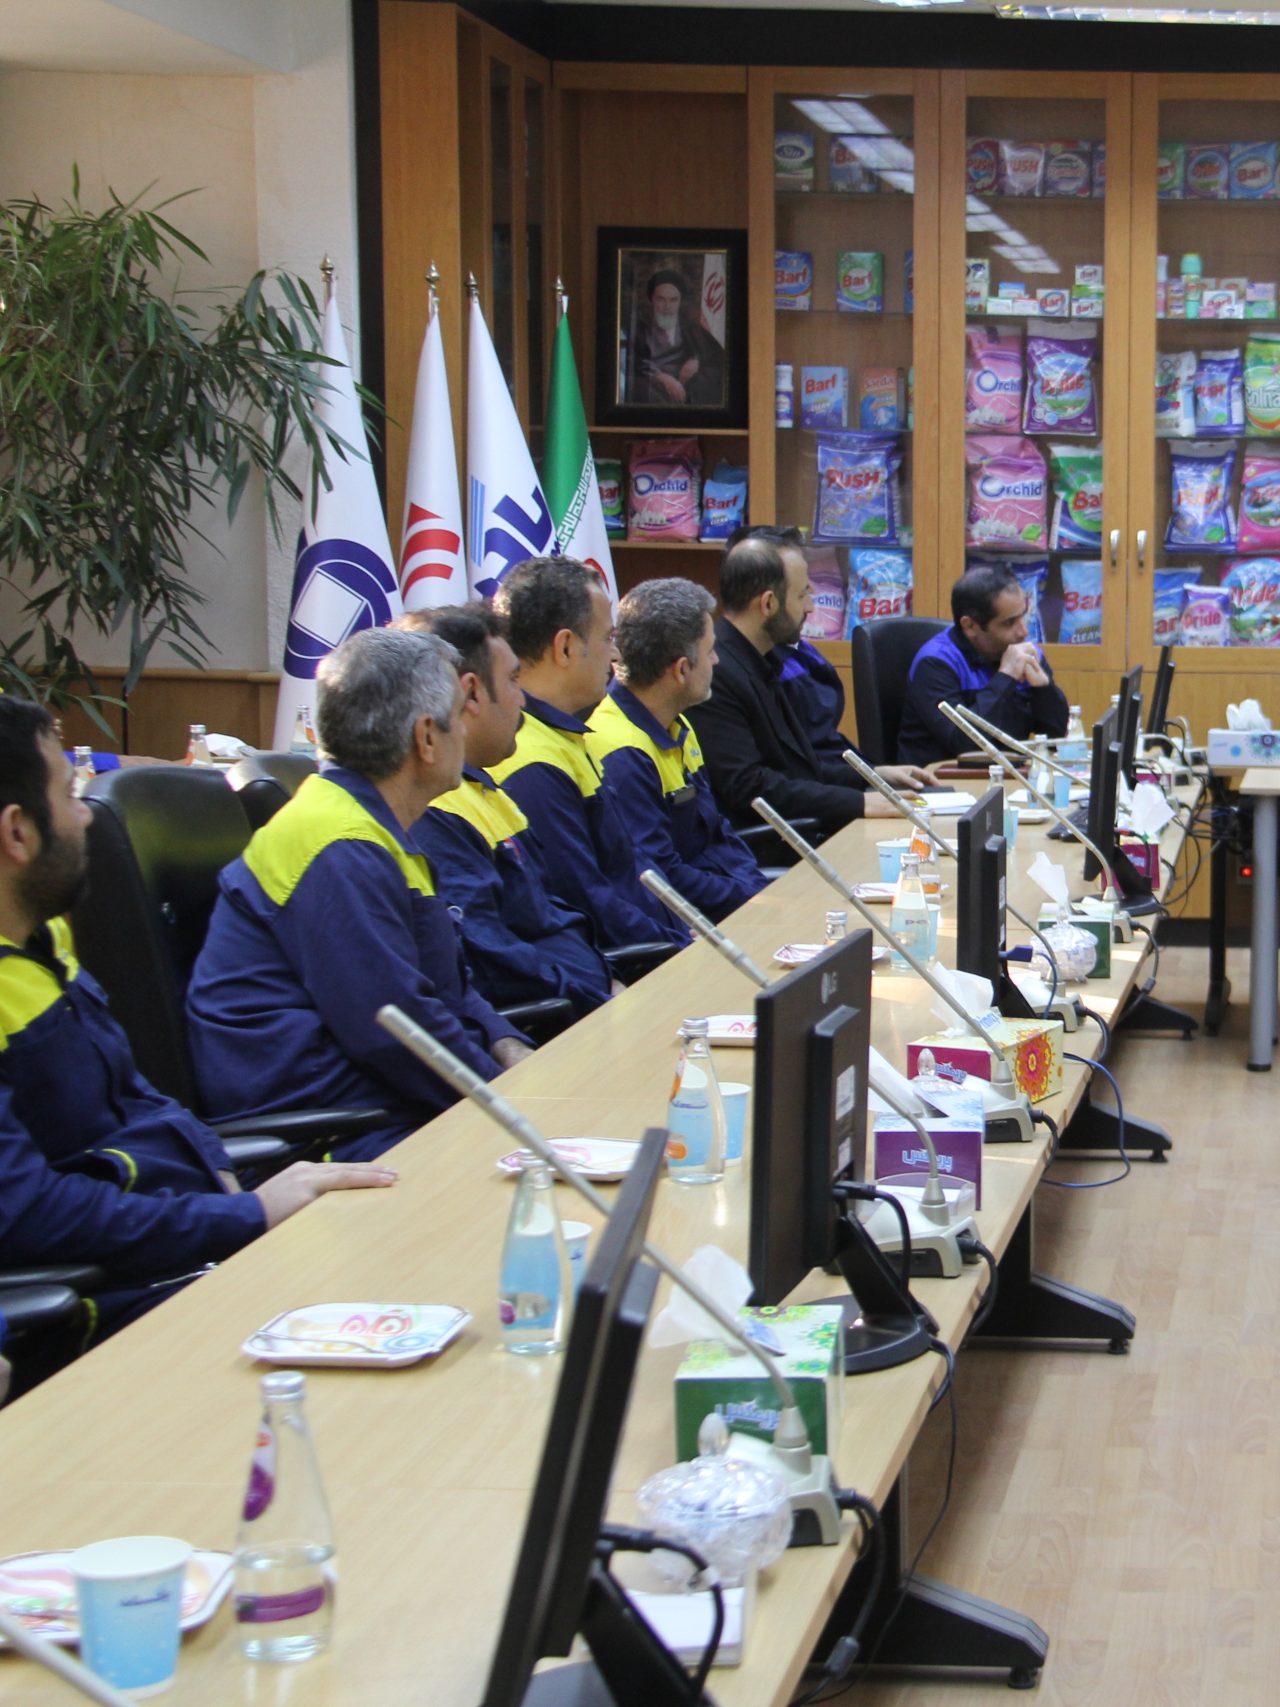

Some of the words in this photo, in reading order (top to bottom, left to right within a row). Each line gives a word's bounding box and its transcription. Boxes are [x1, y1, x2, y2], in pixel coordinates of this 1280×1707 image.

[805, 373, 836, 395] Barf
[634, 473, 689, 496] Orchid
[979, 474, 1043, 498] Orchid
[705, 495, 739, 510] Barf
[1184, 610, 1221, 628] Pride
